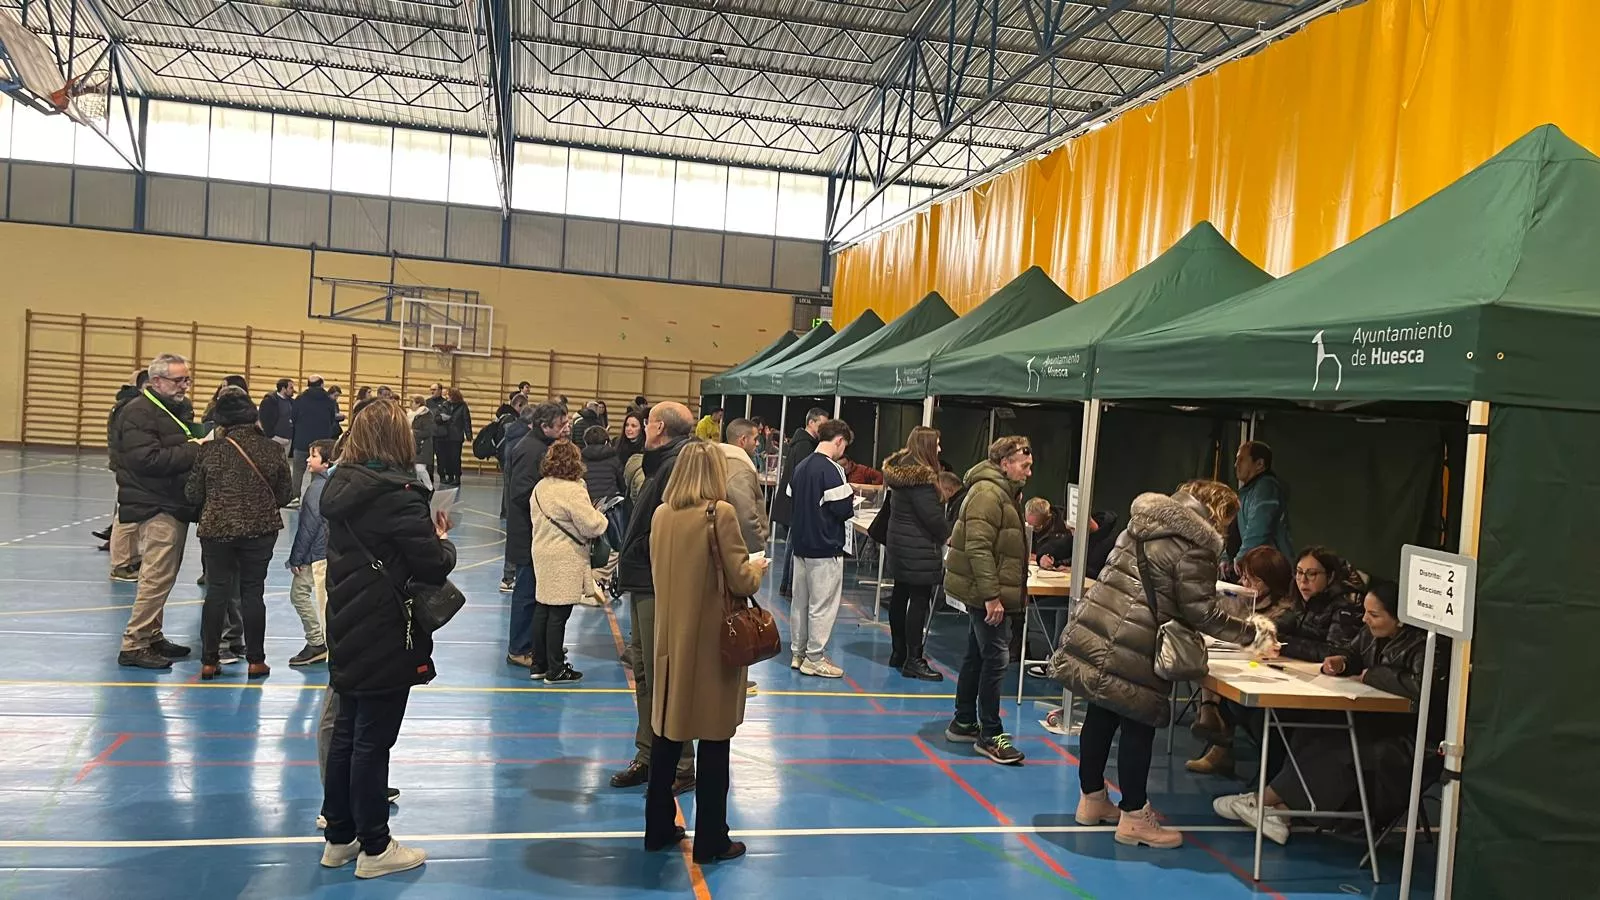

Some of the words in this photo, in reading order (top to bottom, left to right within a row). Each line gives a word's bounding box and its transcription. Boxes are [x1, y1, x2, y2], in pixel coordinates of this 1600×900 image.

[1352, 322, 1453, 348] Ayuntamiento
[1352, 349, 1366, 366] de
[1371, 347, 1425, 365] Huesca
[1420, 569, 1441, 580] Distrito:
[1447, 570, 1454, 582] 2
[1446, 587, 1453, 598] 4
[1417, 600, 1434, 610] Mesa:
[1446, 603, 1453, 615] A
